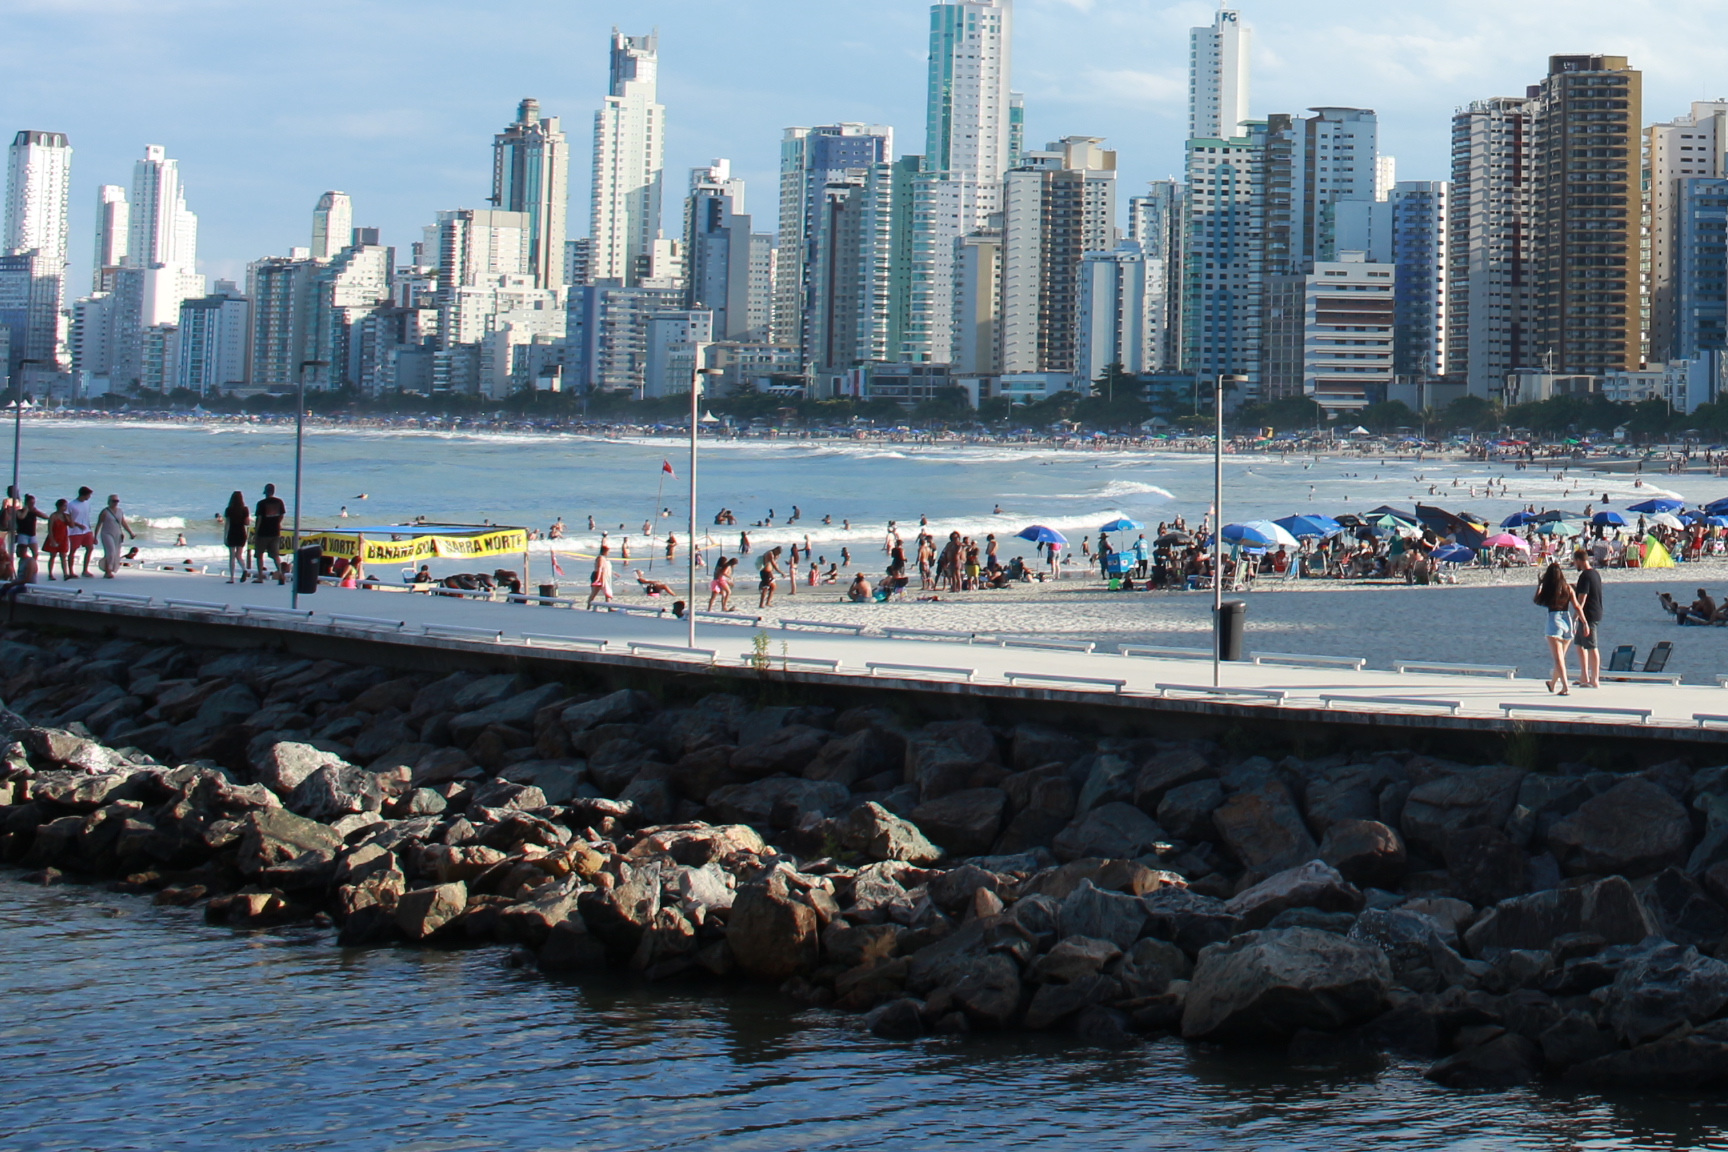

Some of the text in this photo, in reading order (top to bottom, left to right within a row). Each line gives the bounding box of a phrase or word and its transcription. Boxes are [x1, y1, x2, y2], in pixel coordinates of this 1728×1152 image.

[1222, 12, 1237, 22] FG
[416, 538, 438, 554] BOA
[445, 539, 483, 553] BARRA
[484, 534, 522, 550] NORTE
